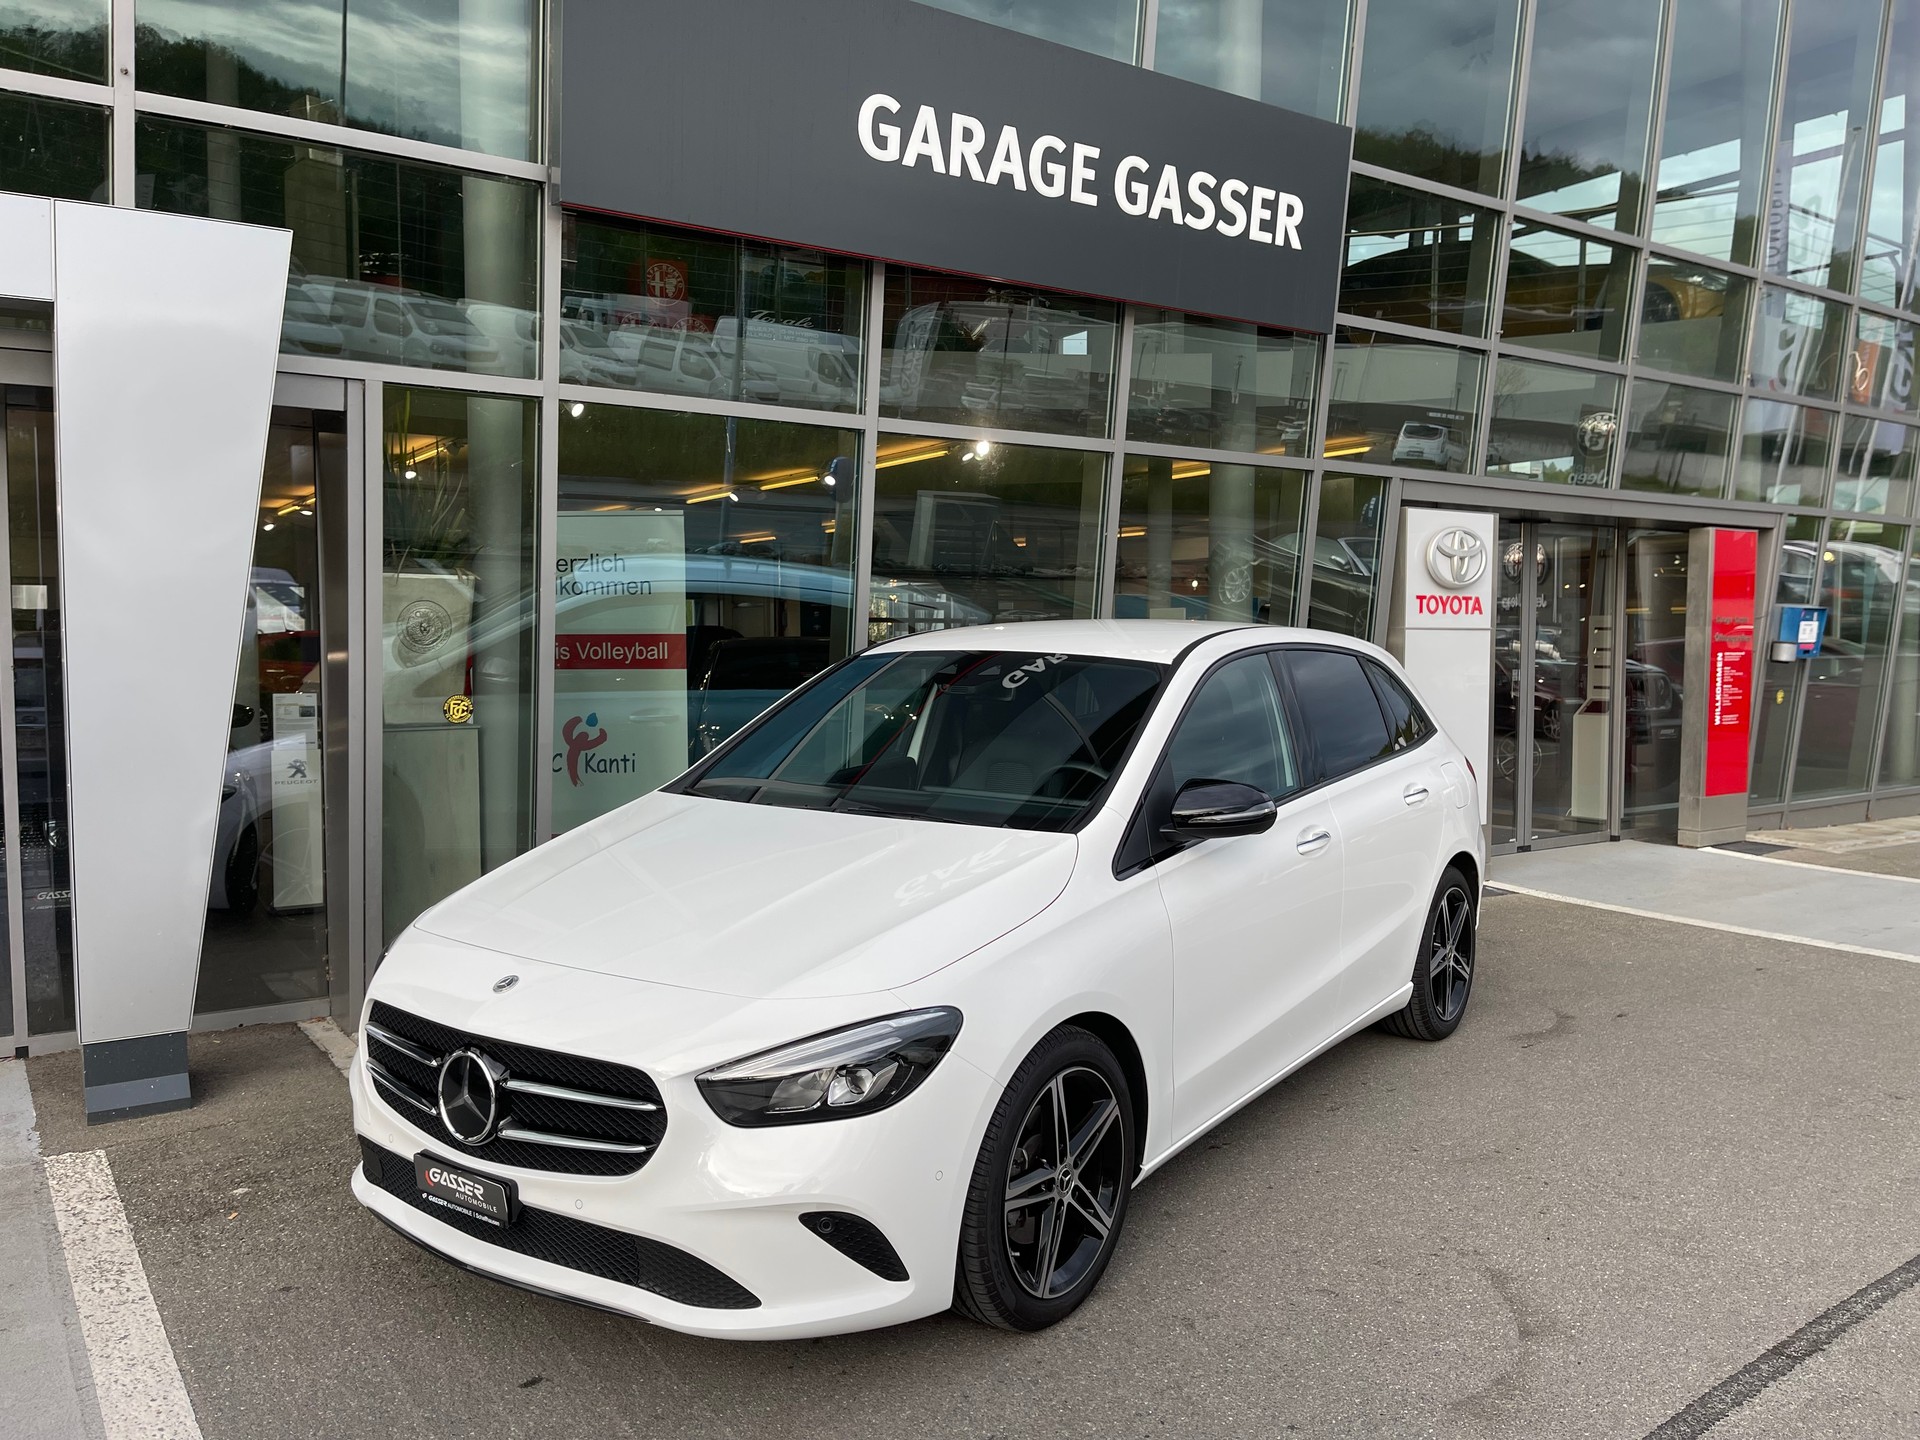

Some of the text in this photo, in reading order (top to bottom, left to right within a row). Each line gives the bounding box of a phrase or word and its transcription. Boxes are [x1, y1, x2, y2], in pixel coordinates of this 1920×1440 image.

[857, 93, 1305, 251] GARAGE GASSER
[1416, 595, 1483, 615] TOYOTA
[576, 642, 668, 664] Volleyball
[1714, 652, 1723, 726] WILLKOMMEN
[584, 752, 636, 774] Kanti
[429, 1167, 484, 1201] GASSER
[455, 1191, 498, 1213] AUTOMOBILE
